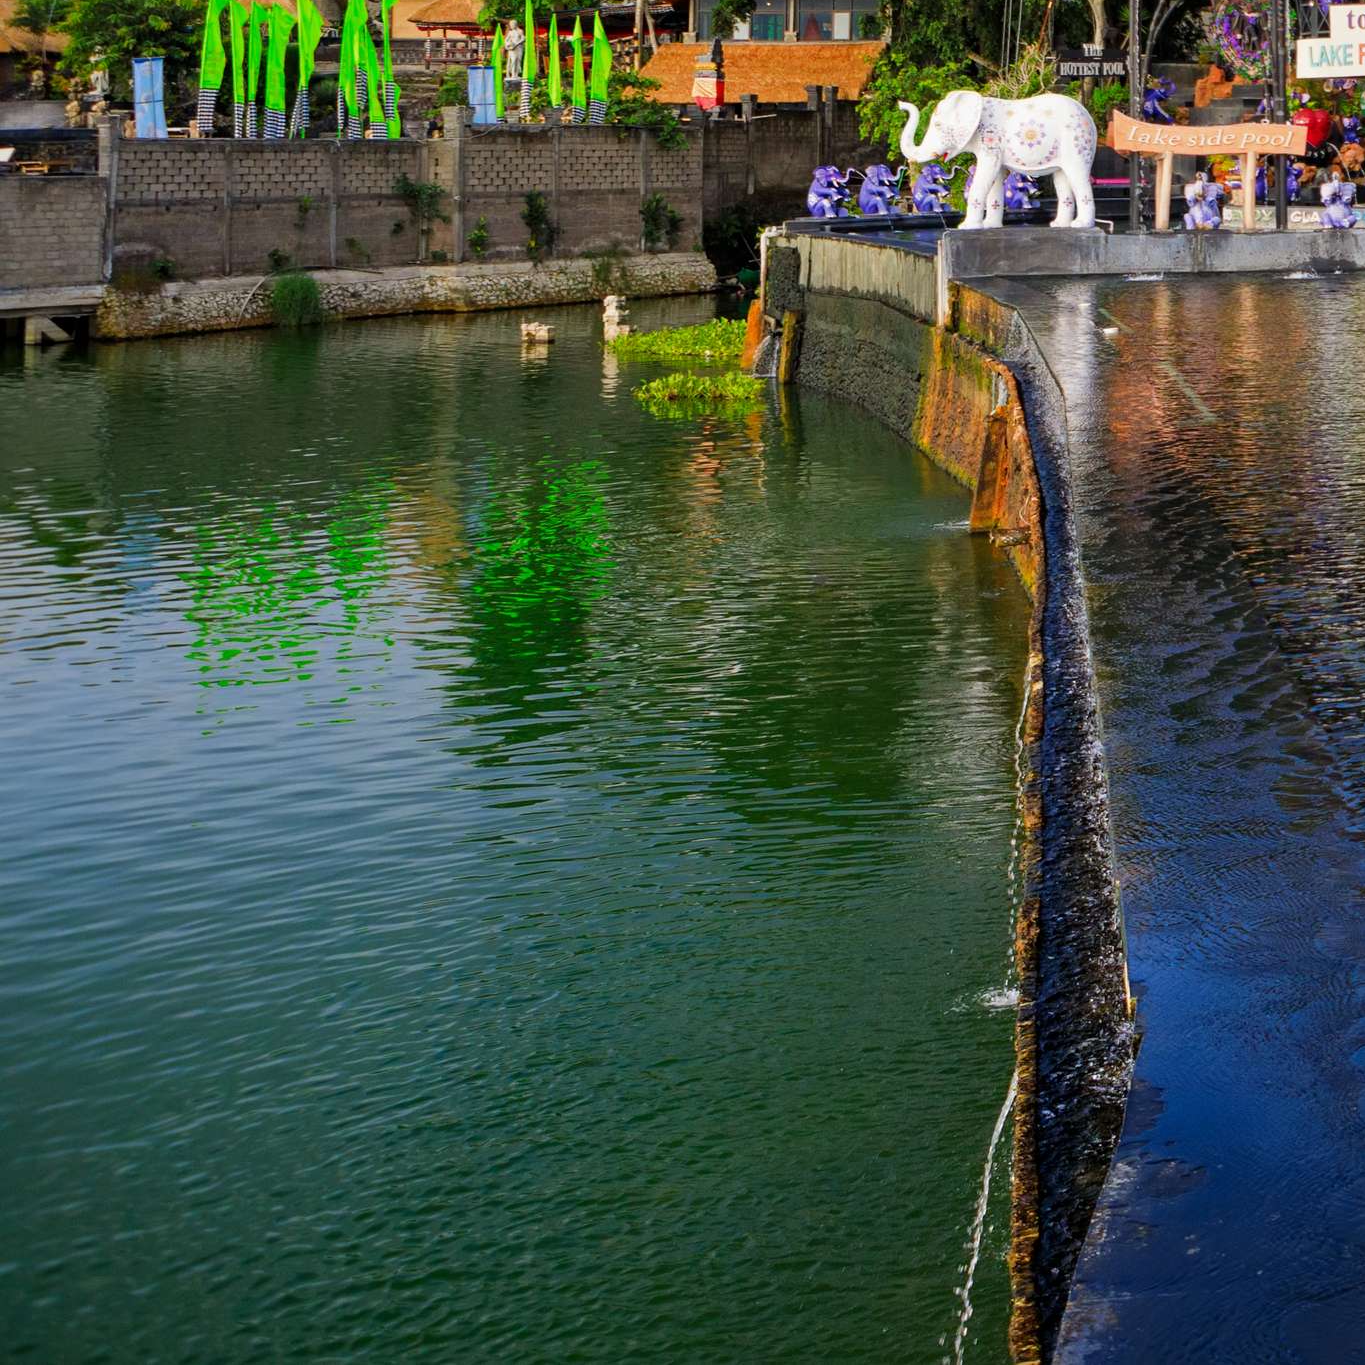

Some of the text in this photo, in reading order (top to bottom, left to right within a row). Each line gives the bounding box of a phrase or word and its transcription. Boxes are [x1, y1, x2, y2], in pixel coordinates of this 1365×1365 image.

[1309, 44, 1353, 68] LAKE
[1060, 62, 1125, 76] HOTTEST POOL
[1127, 126, 1293, 149] Lake side pool
